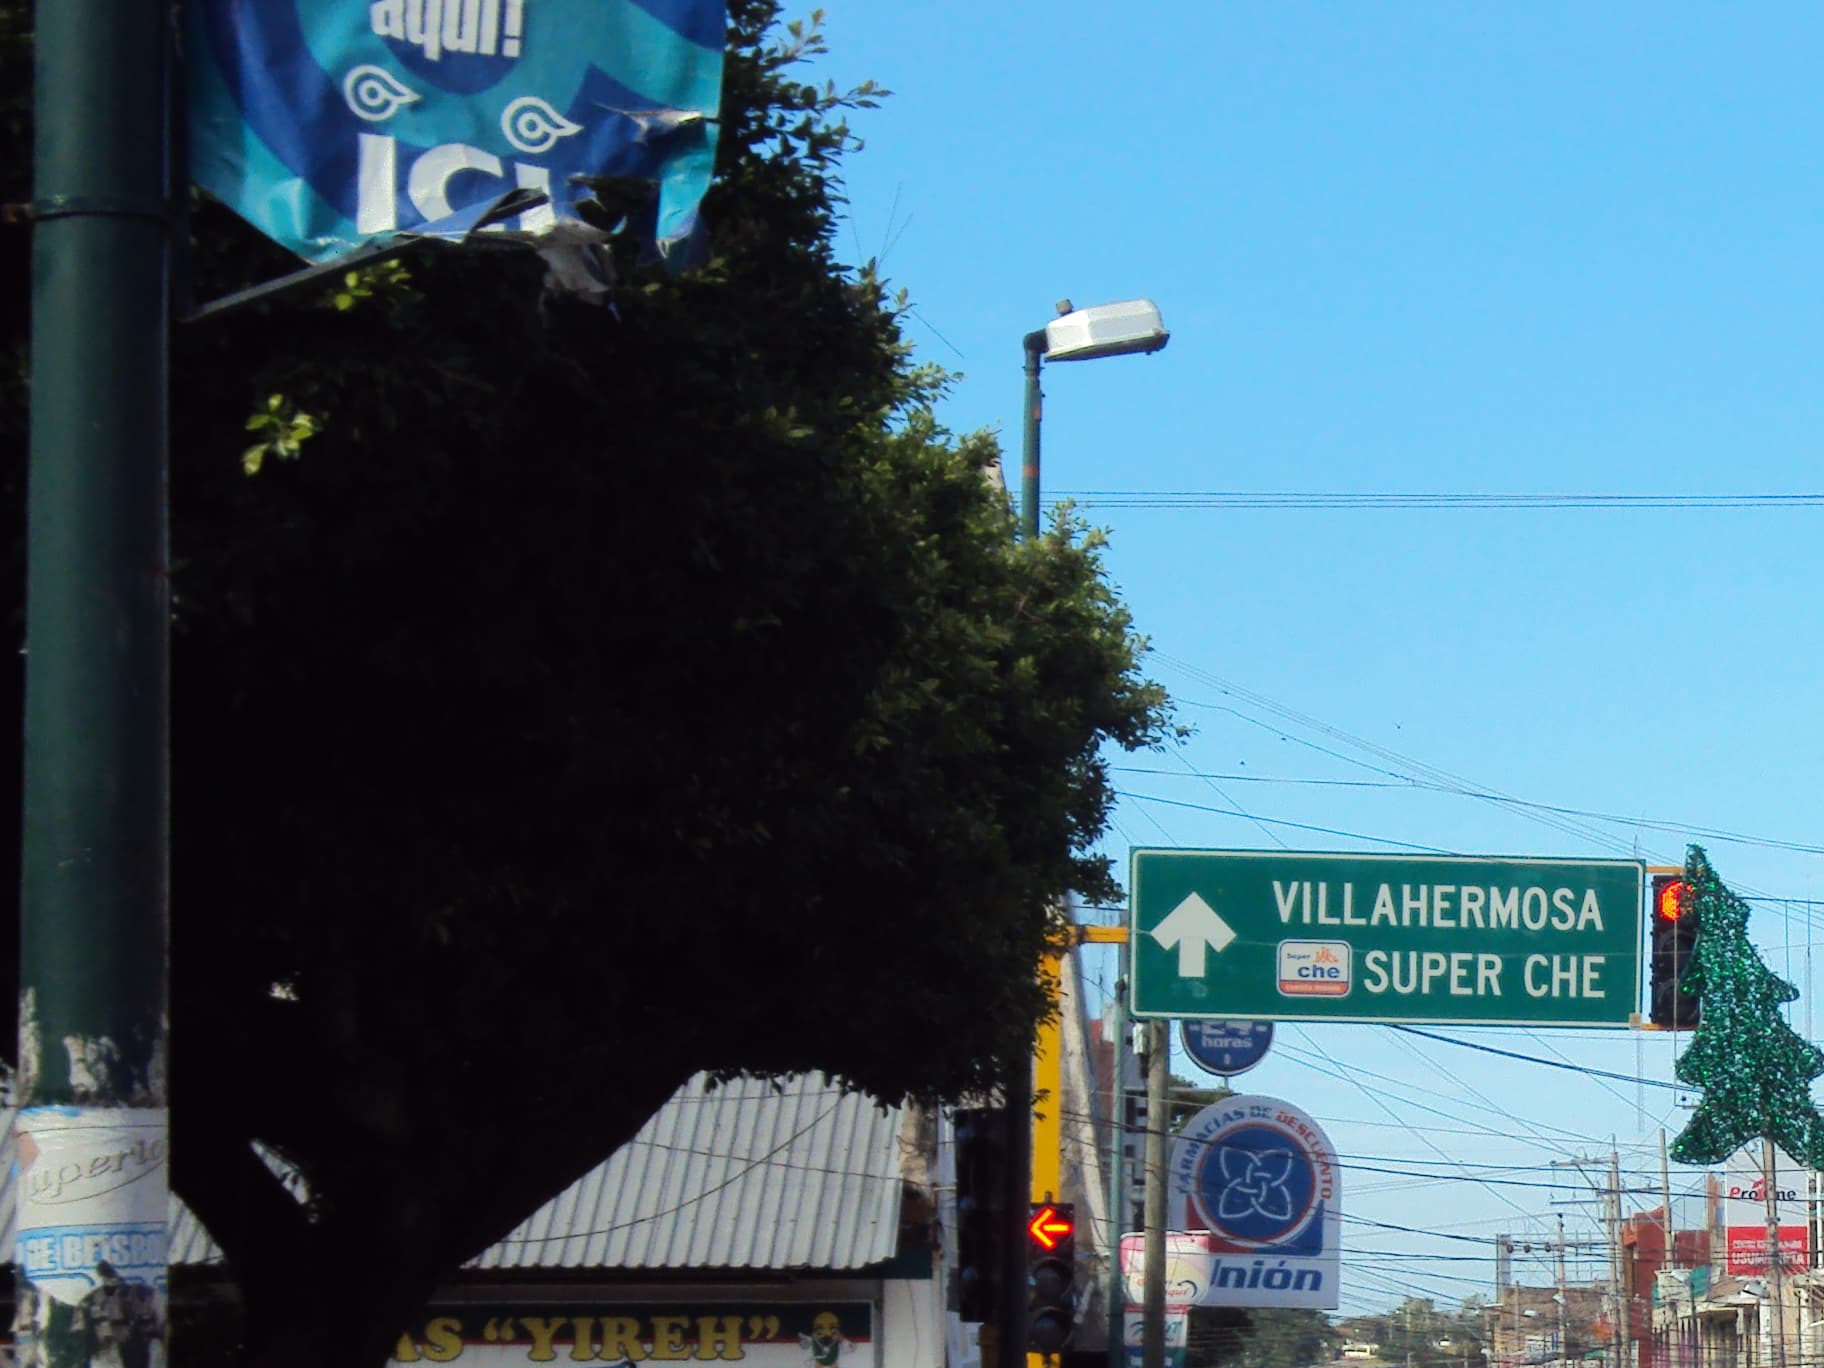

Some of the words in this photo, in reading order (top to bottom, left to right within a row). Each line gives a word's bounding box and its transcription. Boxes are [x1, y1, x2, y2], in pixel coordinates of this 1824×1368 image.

[1272, 880, 1604, 932] VILLAHERMOSA
[1297, 964, 1341, 979] che
[1363, 950, 1502, 997] SUPER
[1523, 956, 1606, 998] CHE
[1202, 1035, 1253, 1049] horas
[1250, 1104, 1274, 1120] DE
[1275, 1110, 1333, 1200] DESCUENTO
